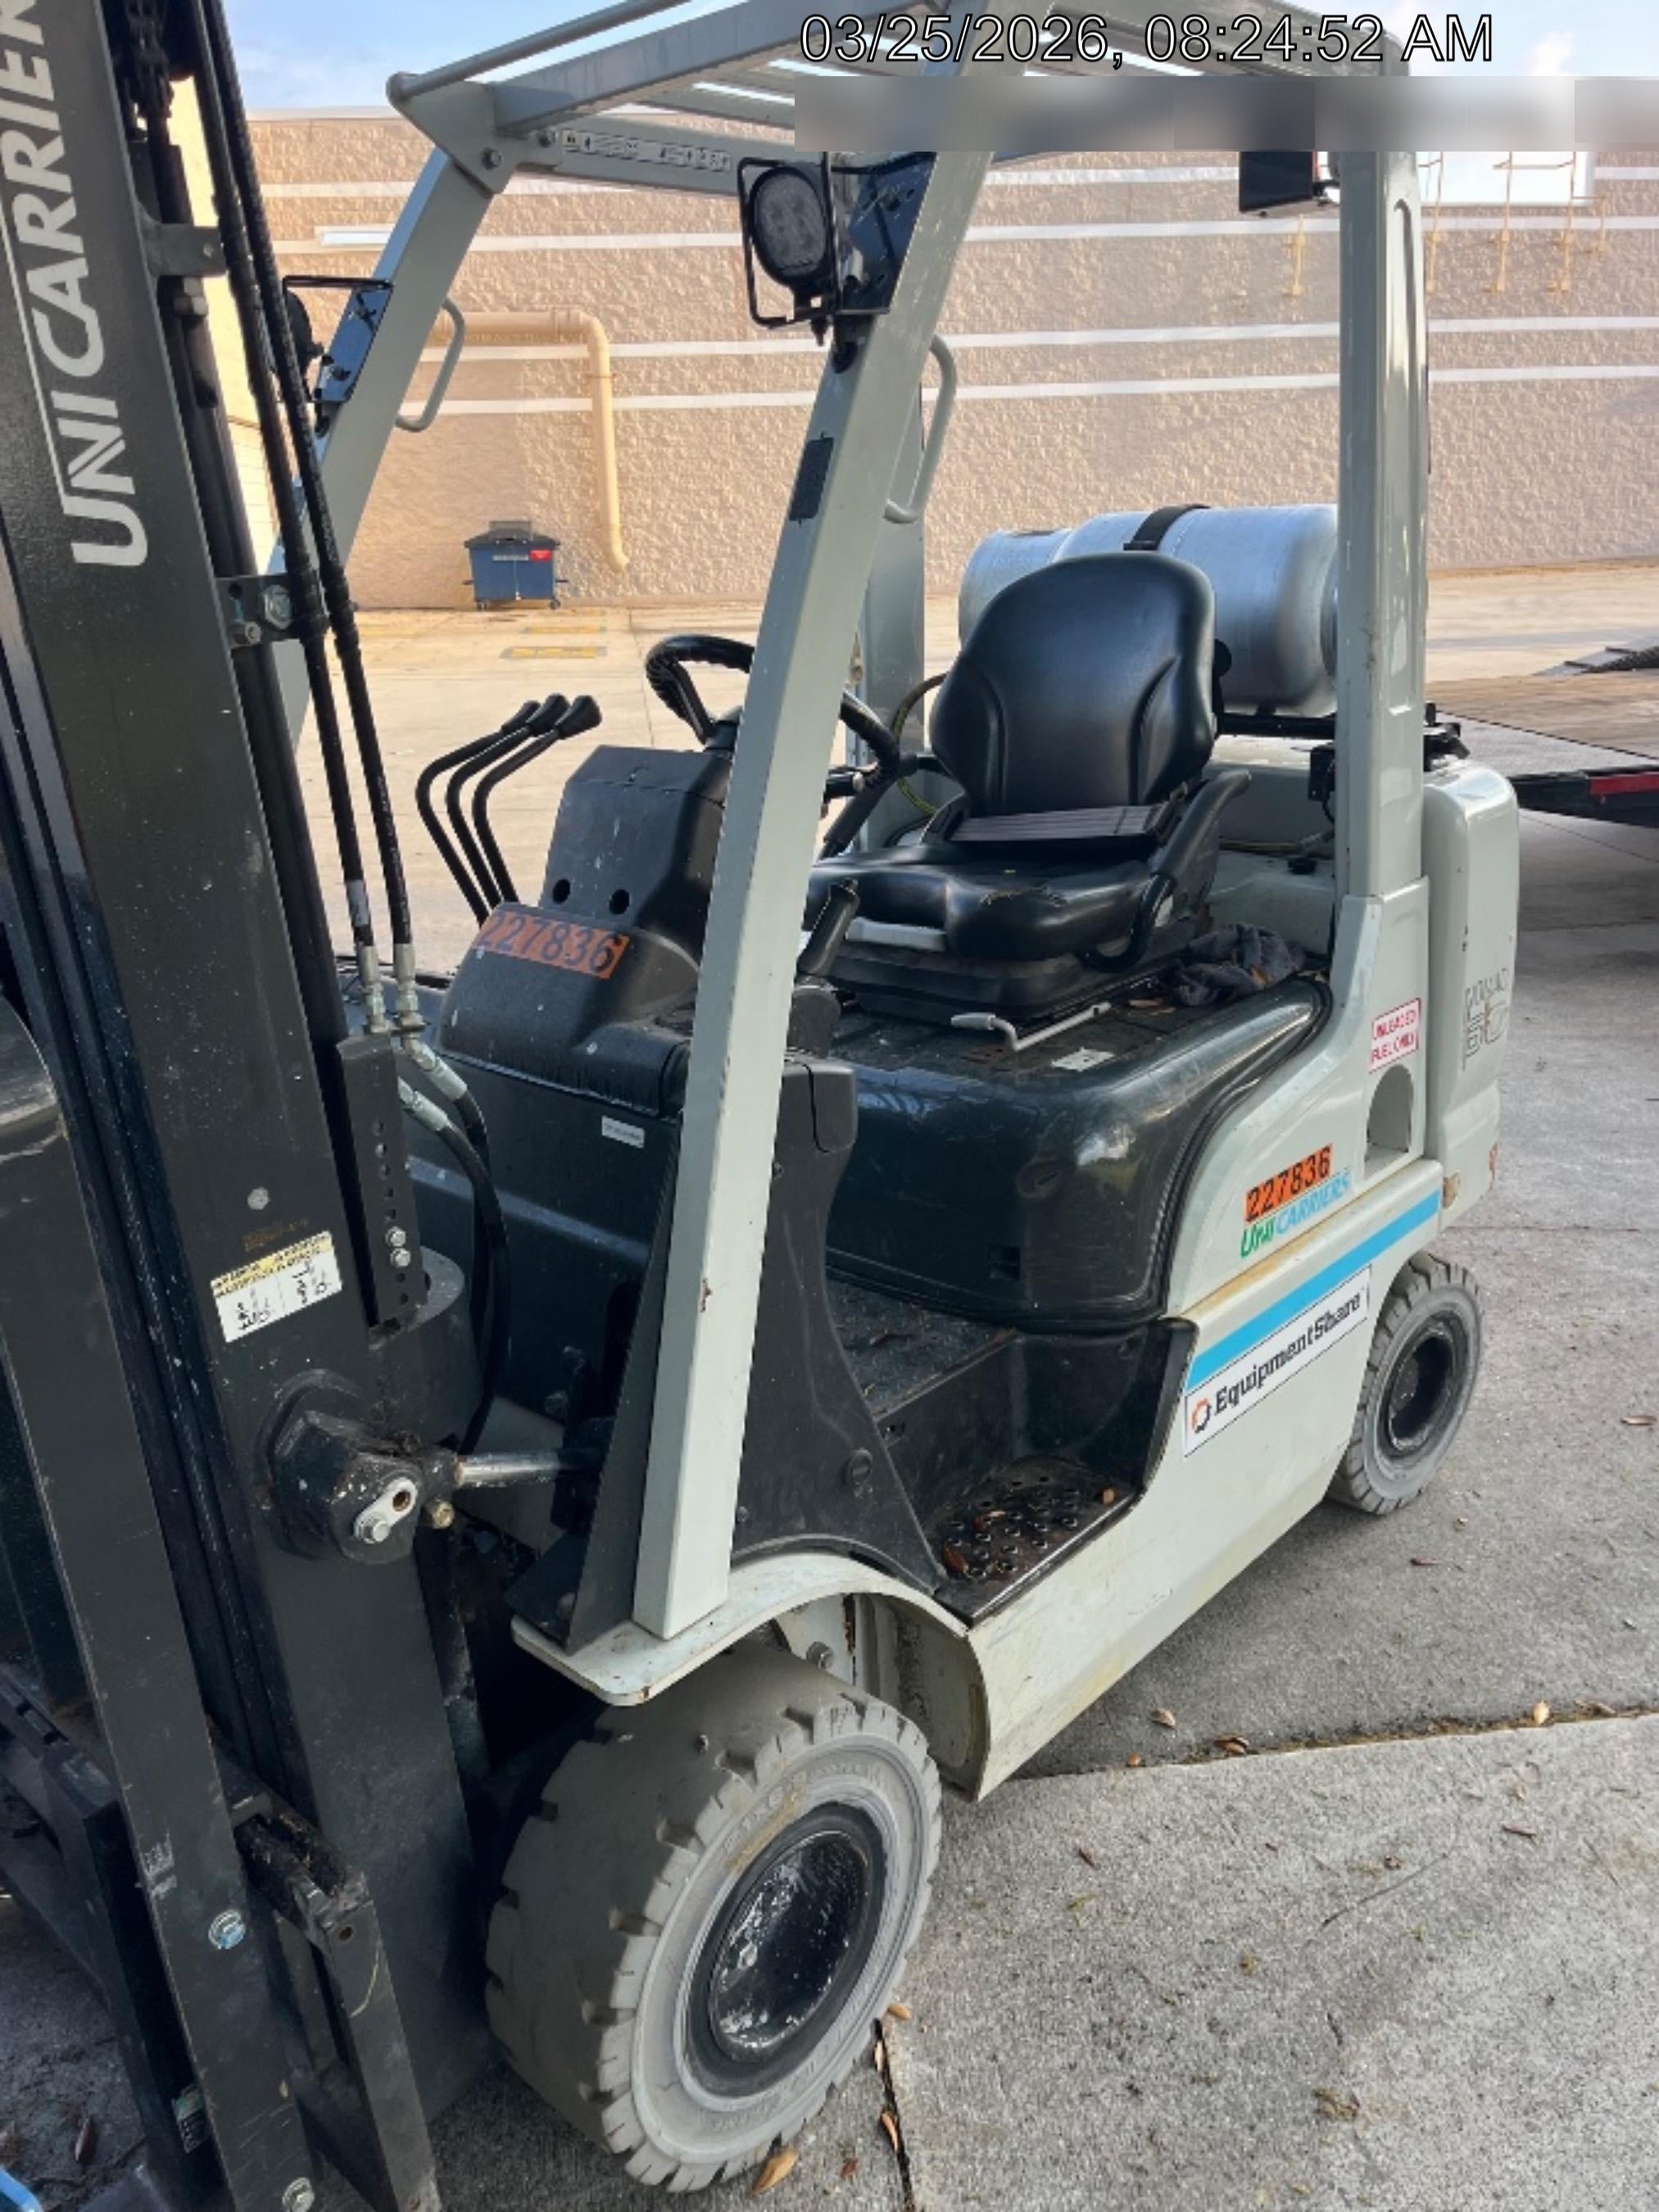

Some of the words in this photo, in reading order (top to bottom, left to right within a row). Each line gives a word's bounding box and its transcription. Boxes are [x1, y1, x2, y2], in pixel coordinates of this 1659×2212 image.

[474, 909, 624, 973] 227836
[1245, 1146, 1331, 1222] 227836
[1214, 1293, 1361, 1416] EquipmentShare
